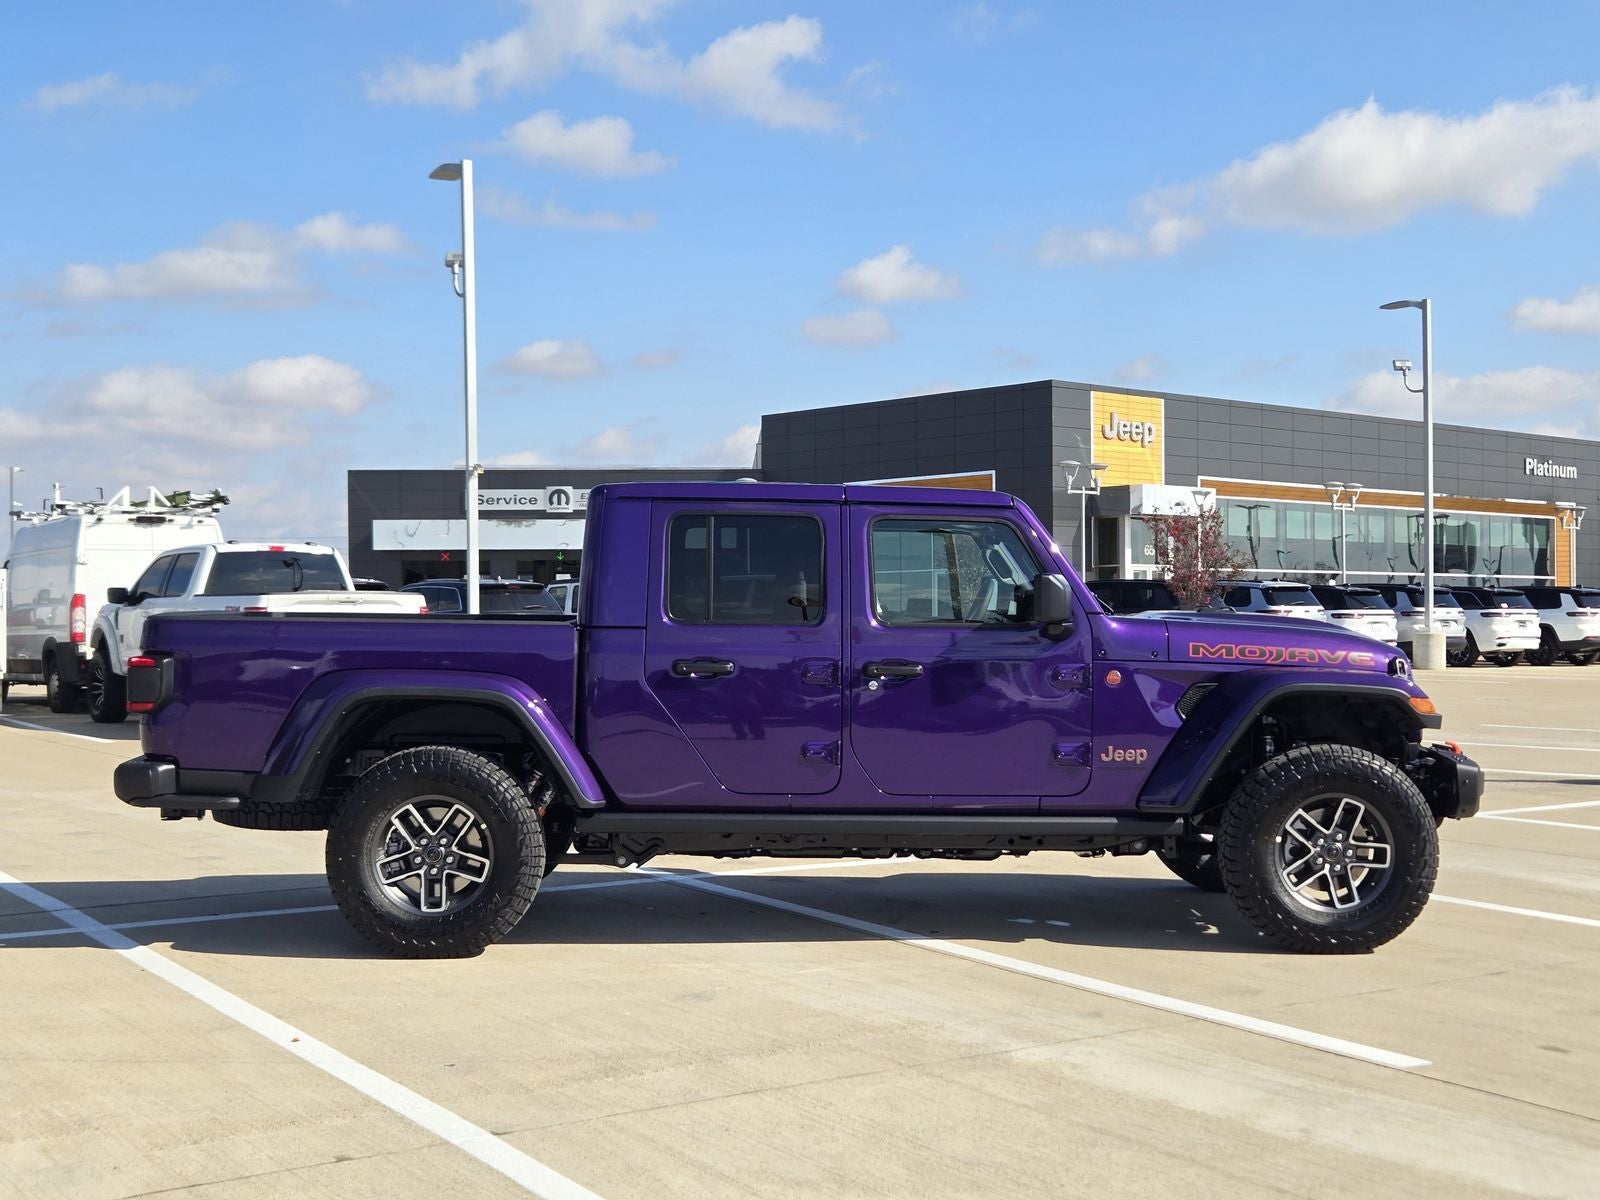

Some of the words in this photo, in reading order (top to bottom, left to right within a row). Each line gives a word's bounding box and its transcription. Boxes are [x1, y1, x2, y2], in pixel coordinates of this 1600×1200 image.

[1102, 412, 1155, 448] Jeep
[1524, 457, 1578, 479] Platinum
[478, 494, 538, 505] Service
[1189, 642, 1375, 666] MOJAVE
[1100, 745, 1148, 764] Jeep
